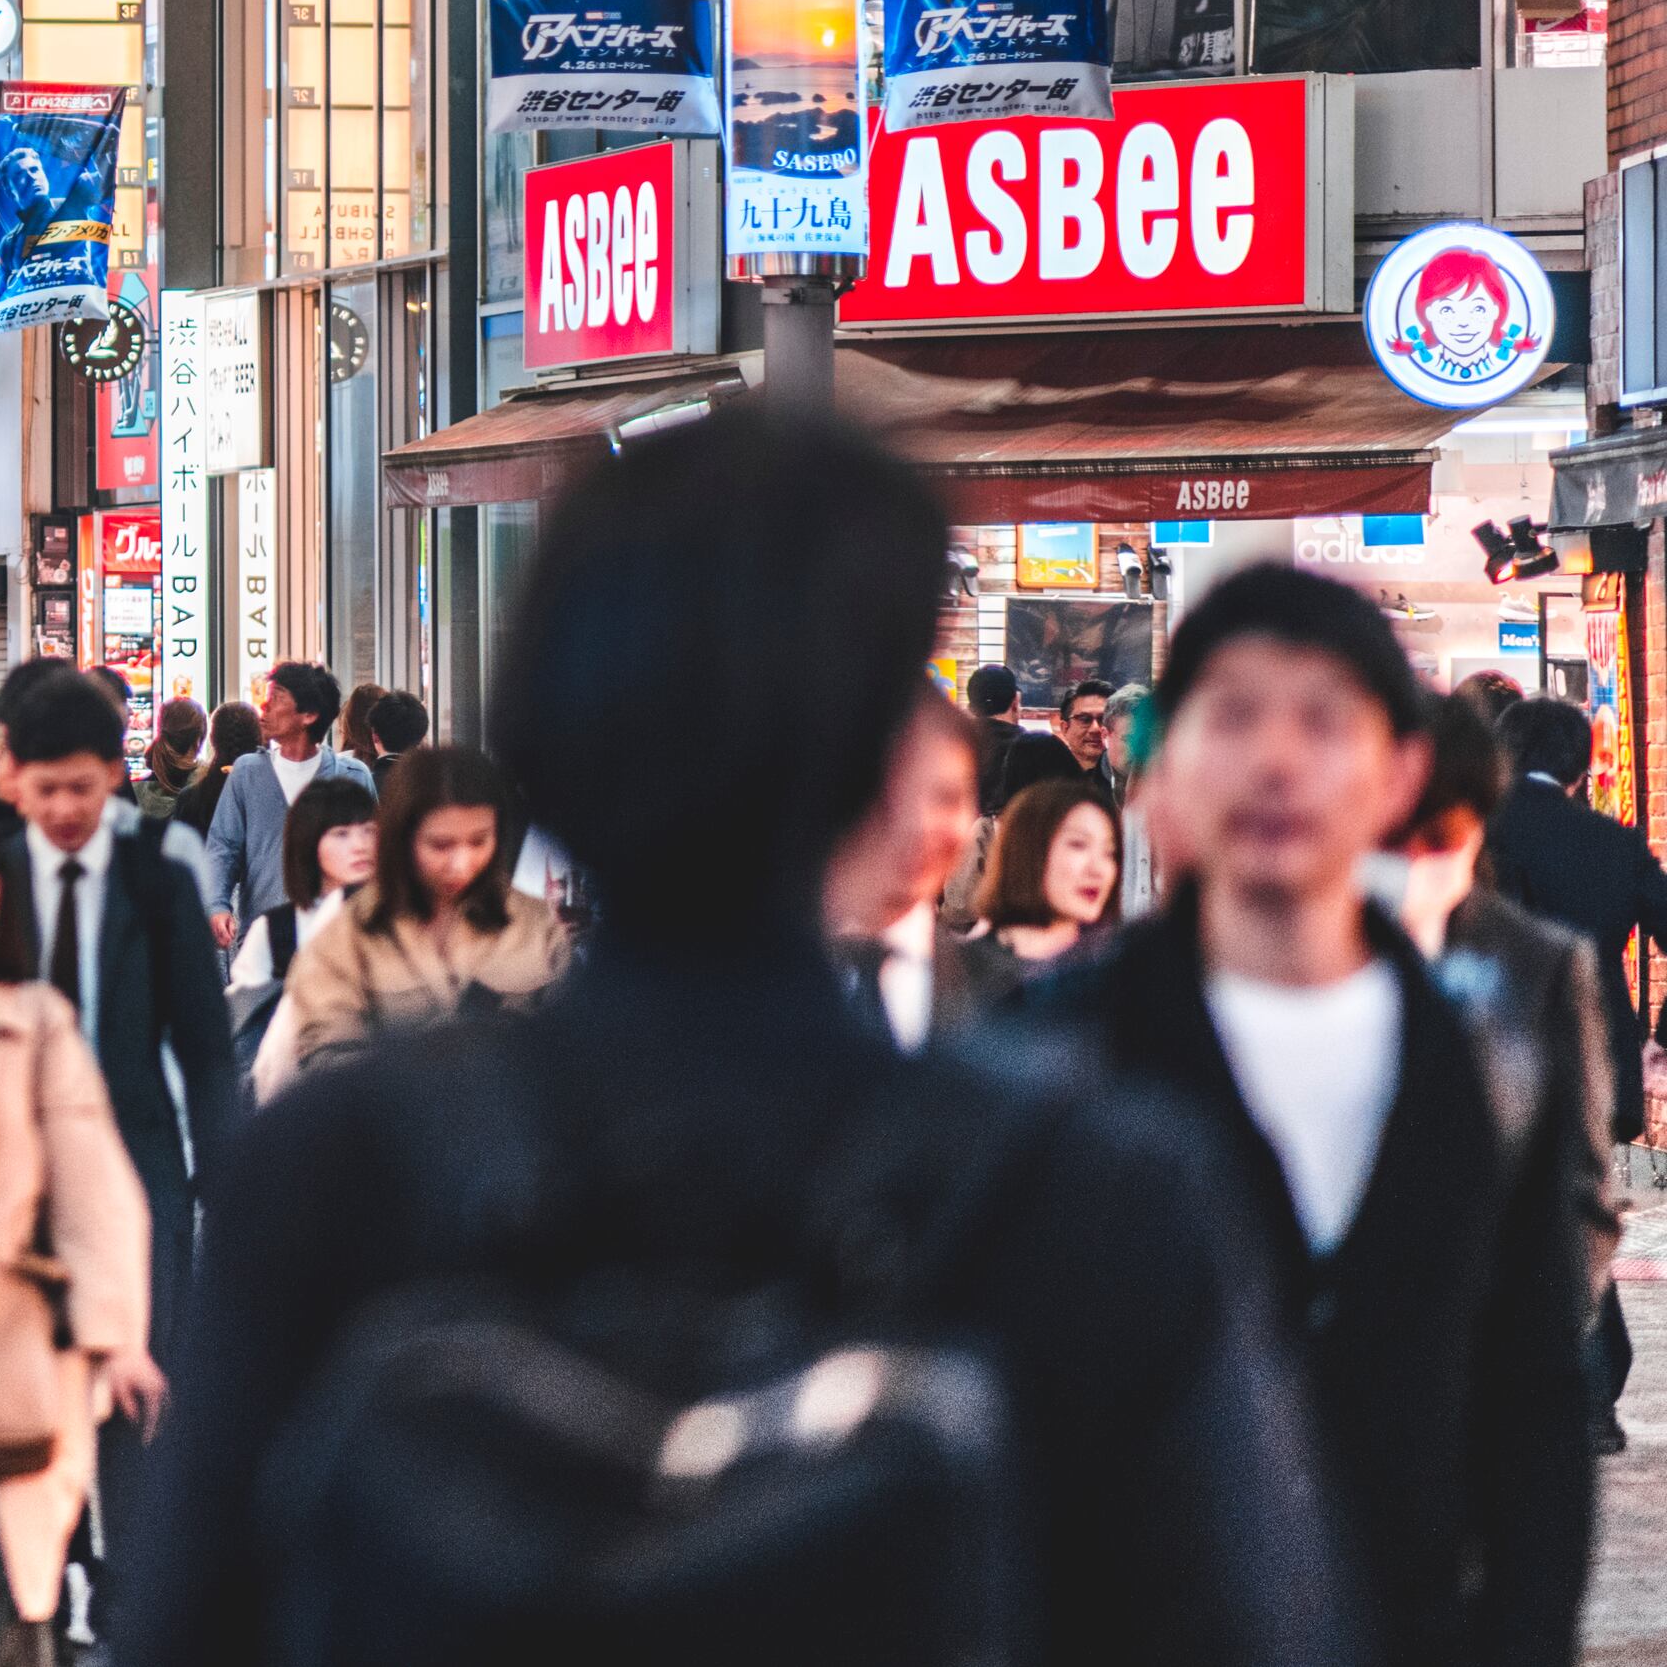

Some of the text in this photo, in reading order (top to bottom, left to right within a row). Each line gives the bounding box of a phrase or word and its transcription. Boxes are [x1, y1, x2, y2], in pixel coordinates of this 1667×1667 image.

[119, 3, 140, 19] 3F
[521, 13, 685, 61] アベンジャーズ
[914, 7, 1079, 57] アベンジャーズ
[30, 94, 107, 111] #0426逆襲へ
[516, 89, 687, 113] 渋谷センター街
[908, 77, 1080, 109] 渋谷センター街
[119, 167, 140, 183] 1F
[771, 147, 858, 173] SASEBO
[738, 196, 852, 231] 九十九島
[884, 116, 1256, 288] ASBee
[119, 249, 140, 267] B1
[538, 179, 659, 335] ASBee
[168, 319, 199, 659] 渋谷ハイボール BAR
[1175, 479, 1251, 512] ASBee
